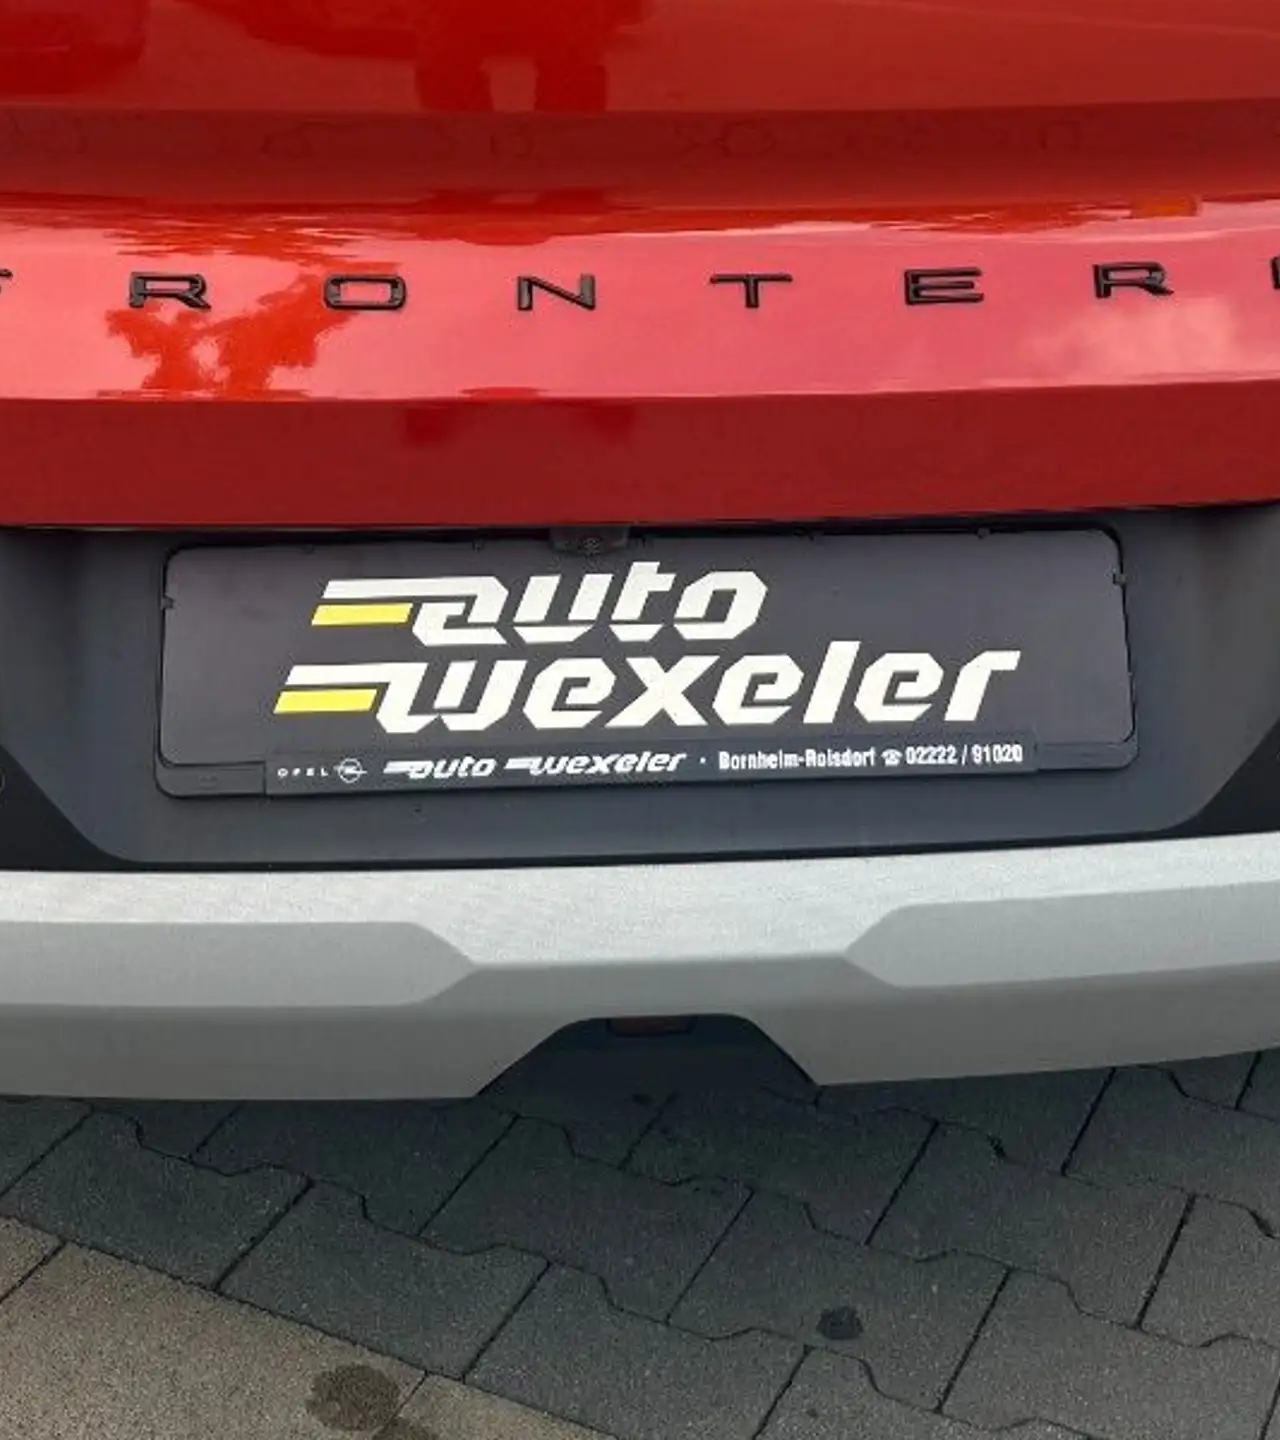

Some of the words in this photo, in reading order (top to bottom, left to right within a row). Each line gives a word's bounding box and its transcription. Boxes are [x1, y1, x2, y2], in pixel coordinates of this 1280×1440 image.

[322, 561, 769, 647] auto
[284, 640, 1022, 734] wexeler
[384, 757, 497, 779] auto
[505, 751, 688, 776] wexeler
[718, 747, 876, 770] Bornheim-Roisdorf
[904, 745, 958, 766] 02222
